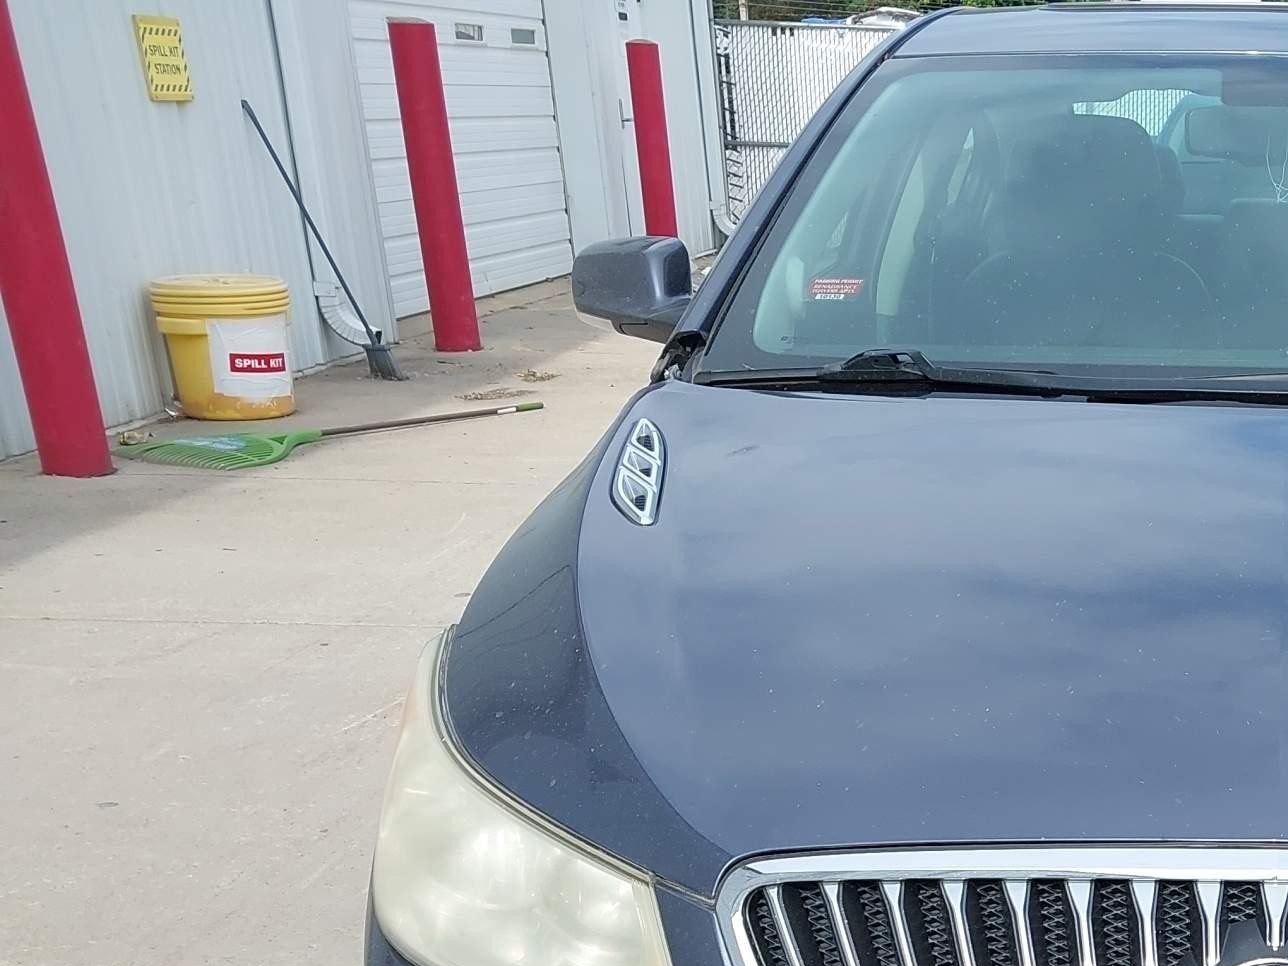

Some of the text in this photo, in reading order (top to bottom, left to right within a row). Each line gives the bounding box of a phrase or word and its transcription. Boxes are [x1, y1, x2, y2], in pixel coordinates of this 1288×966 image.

[148, 45, 179, 58] SPILL KIT
[154, 63, 182, 75] STATION
[234, 358, 283, 368] SPILL KIT
